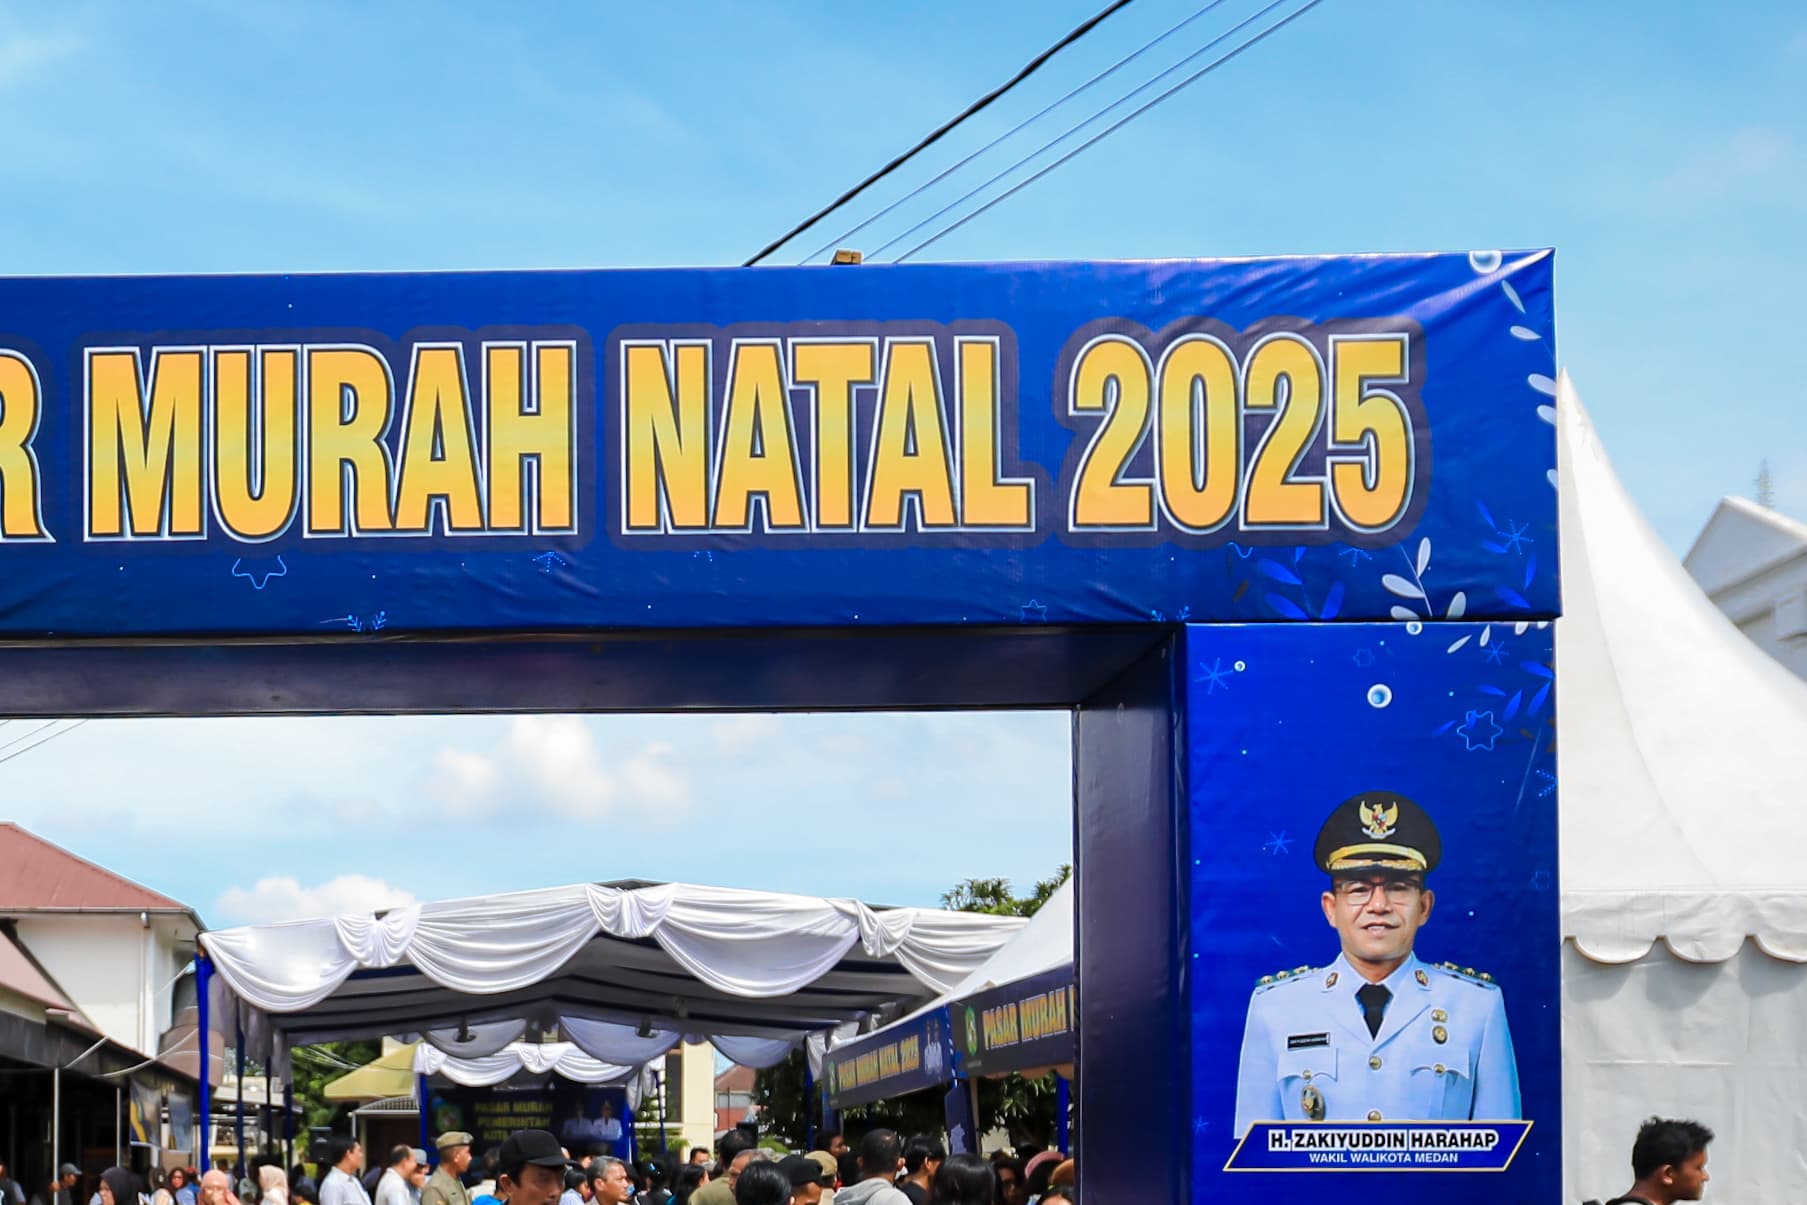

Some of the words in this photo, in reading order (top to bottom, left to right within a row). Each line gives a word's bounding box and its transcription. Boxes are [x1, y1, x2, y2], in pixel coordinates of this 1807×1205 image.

[83, 339, 578, 543] MURAH
[619, 333, 1036, 535] NATAL
[1067, 331, 1414, 535] 2025
[982, 1002, 1019, 1050] PASAR
[1019, 986, 1068, 1045] MURAH
[1269, 1129, 1291, 1151] H.
[1293, 1129, 1406, 1151] ZAKIYUDDIN
[1409, 1129, 1498, 1151] HARAHAP
[1309, 1153, 1347, 1163] WAKIL
[1350, 1153, 1411, 1163] WALIKOTA
[1415, 1153, 1458, 1163] MEDAN
